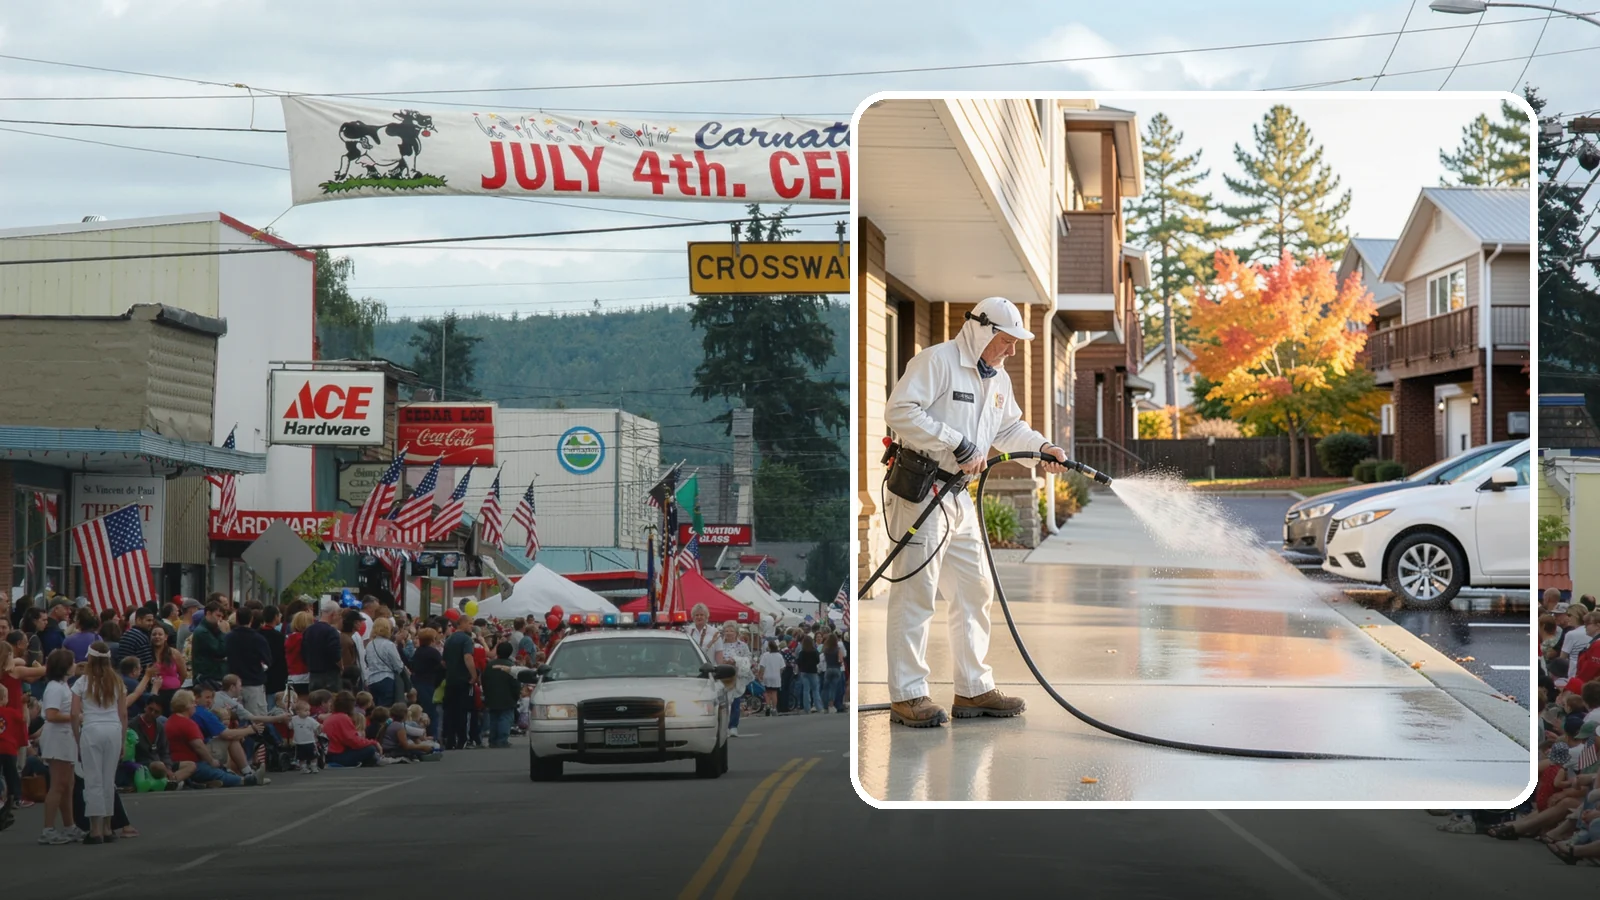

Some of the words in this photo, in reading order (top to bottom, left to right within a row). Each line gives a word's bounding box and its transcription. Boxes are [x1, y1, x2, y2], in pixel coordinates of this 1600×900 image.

[695, 121, 850, 150] Carnat
[481, 140, 605, 193] JULY
[632, 150, 747, 198] 4th.
[696, 254, 850, 280] CROSSWA
[283, 380, 373, 420] ACE
[405, 409, 453, 422] CEDAR
[461, 409, 486, 422] LOG
[283, 421, 371, 437] Hardware
[416, 428, 477, 447] Coca-Cola
[353, 467, 384, 480] Simpl
[95, 485, 124, 494] Vincent
[126, 486, 136, 494] de
[138, 486, 155, 495] Paul
[213, 516, 330, 535] HARDARE
[688, 527, 741, 535] CRNATION
[699, 535, 730, 543] GLASS
